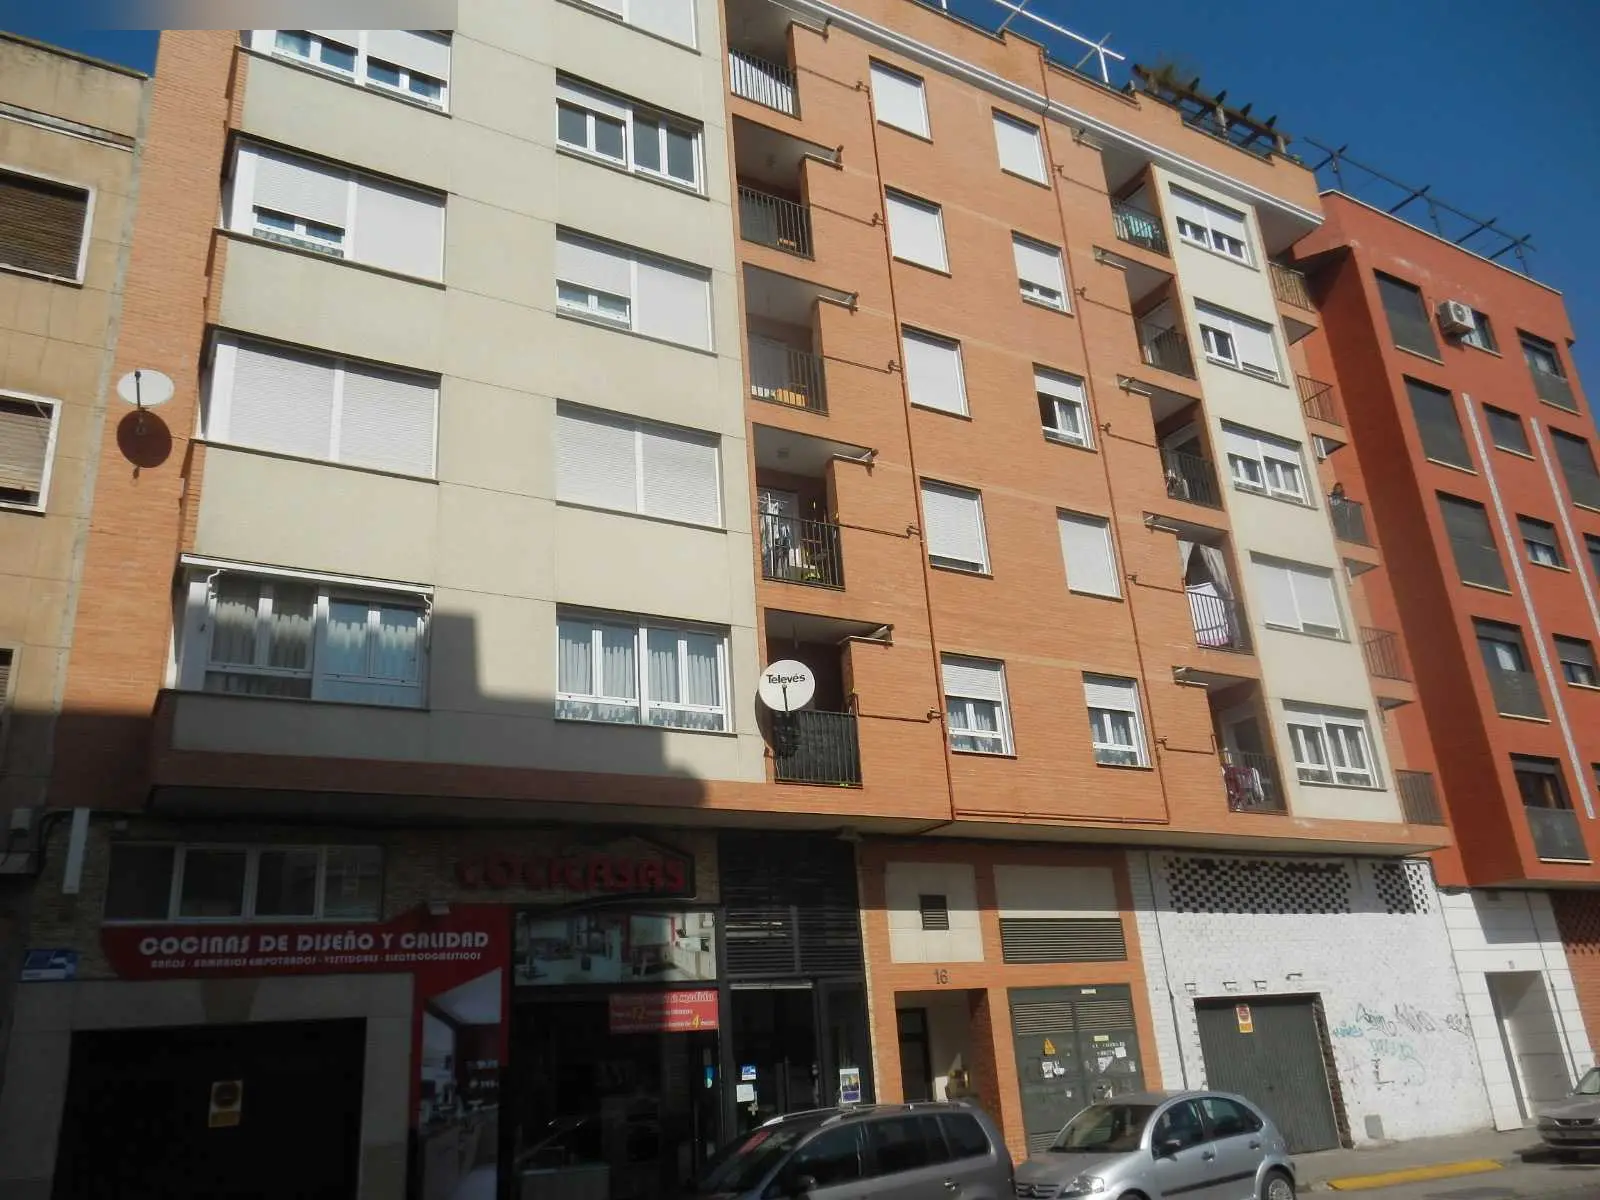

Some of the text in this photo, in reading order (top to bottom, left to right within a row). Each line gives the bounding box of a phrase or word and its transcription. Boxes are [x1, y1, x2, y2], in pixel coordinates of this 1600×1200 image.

[766, 673, 806, 684] Televés
[138, 930, 489, 956] COCINAS DE DISEÑO Y CALIDAD
[934, 968, 949, 985] 16
